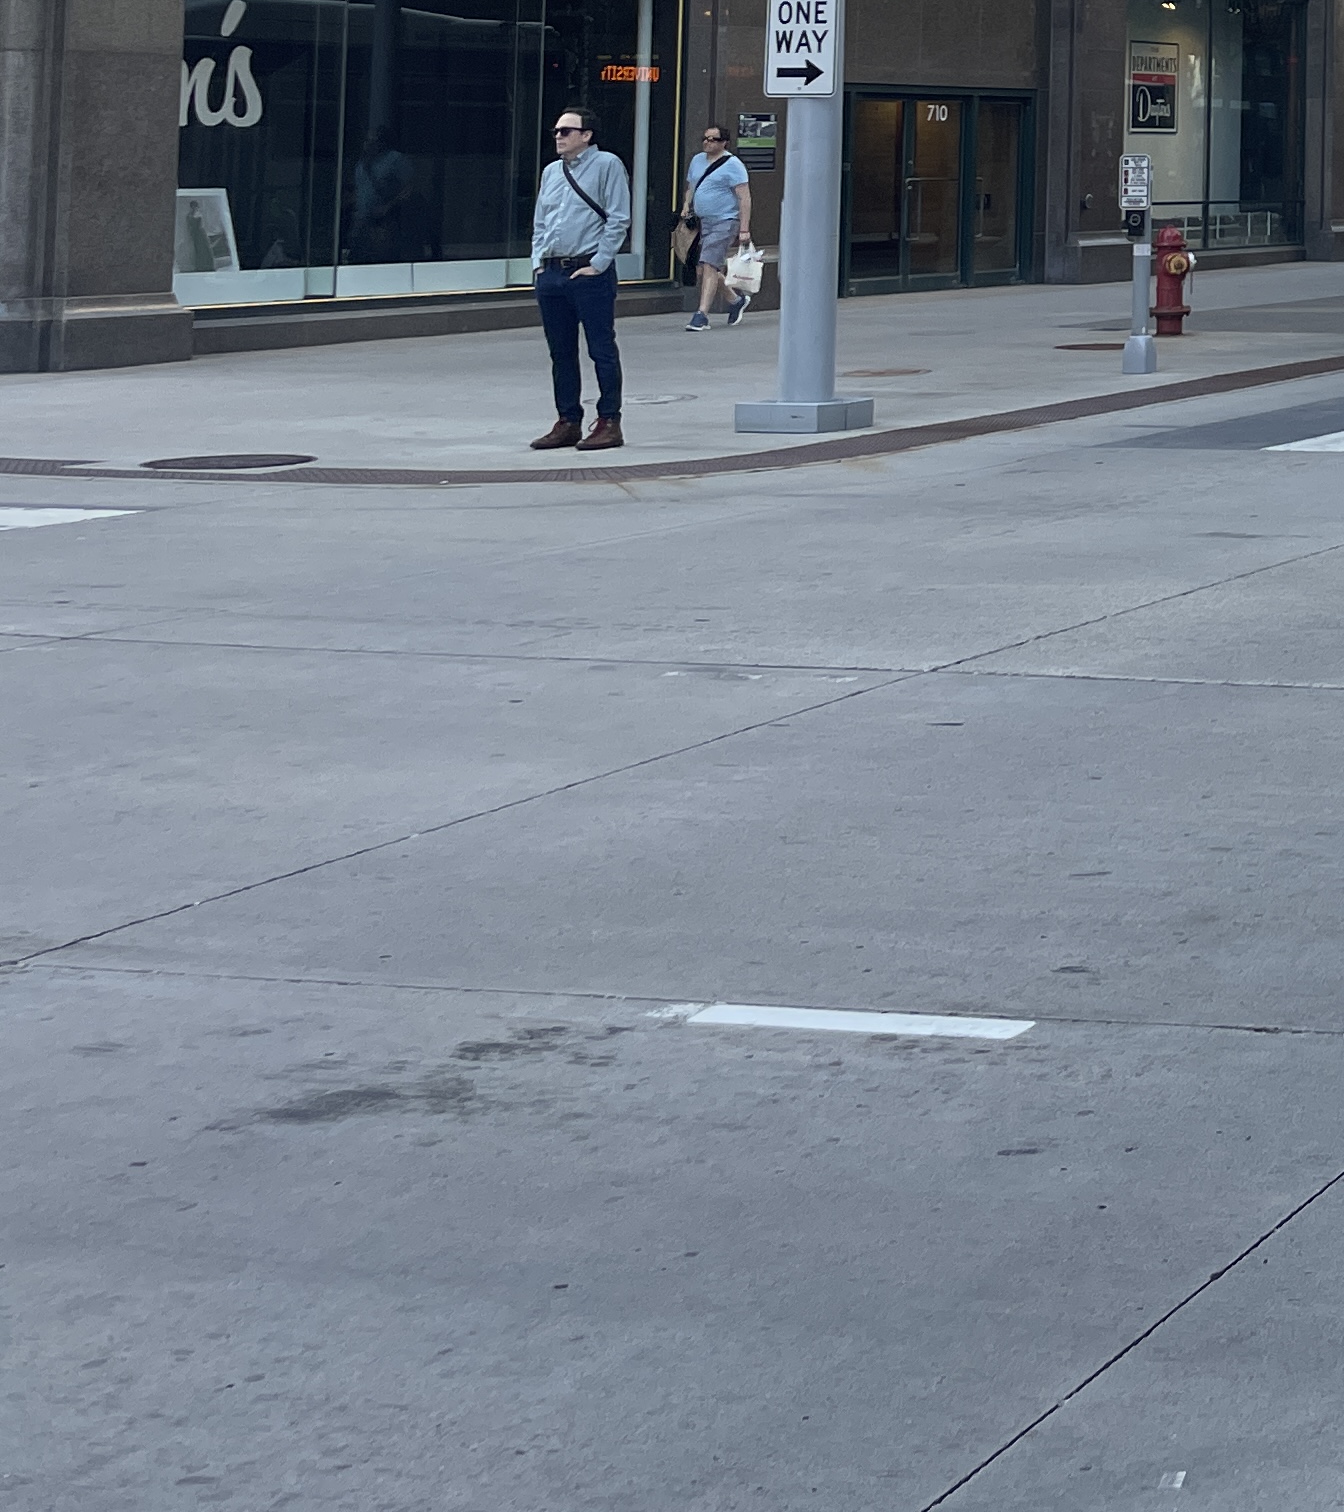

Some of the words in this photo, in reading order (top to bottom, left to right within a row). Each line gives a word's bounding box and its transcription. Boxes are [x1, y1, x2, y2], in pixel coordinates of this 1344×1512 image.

[778, 0, 828, 25] ONE
[775, 29, 829, 54] WAY
[926, 104, 949, 121] 710
